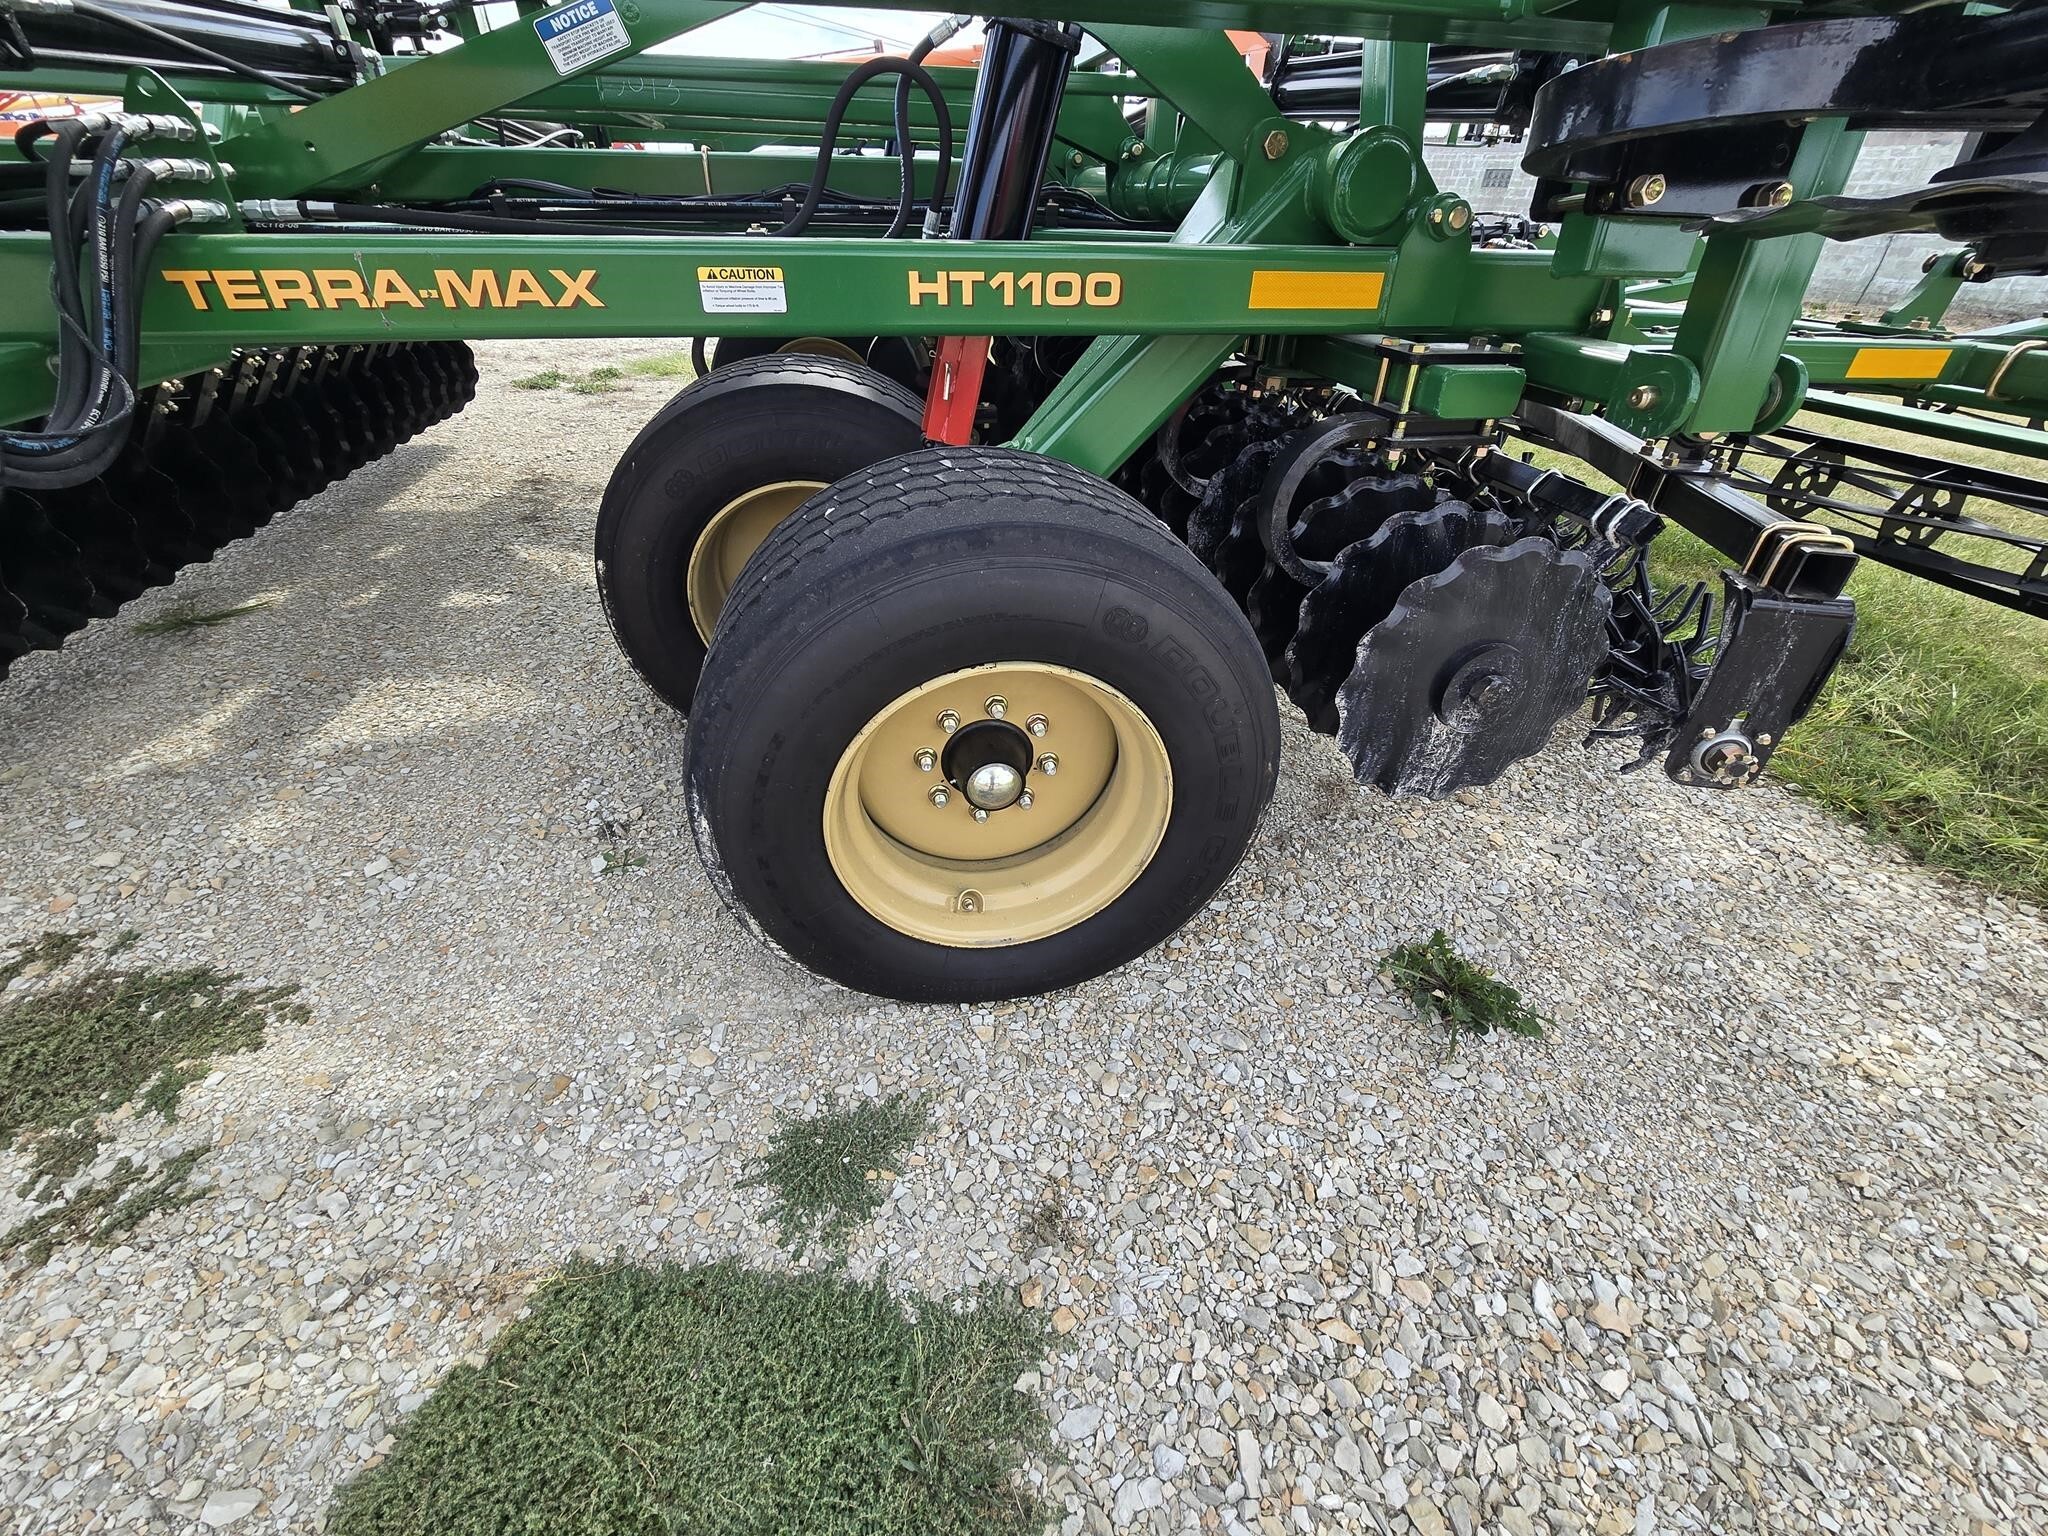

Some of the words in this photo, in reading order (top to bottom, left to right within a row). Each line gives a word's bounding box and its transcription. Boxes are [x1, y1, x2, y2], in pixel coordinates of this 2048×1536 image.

[550, 1, 599, 32] NOTICE
[719, 268, 775, 280] CAUTION
[908, 270, 1122, 307] HT1100
[1146, 633, 1242, 823] DOUBLE
